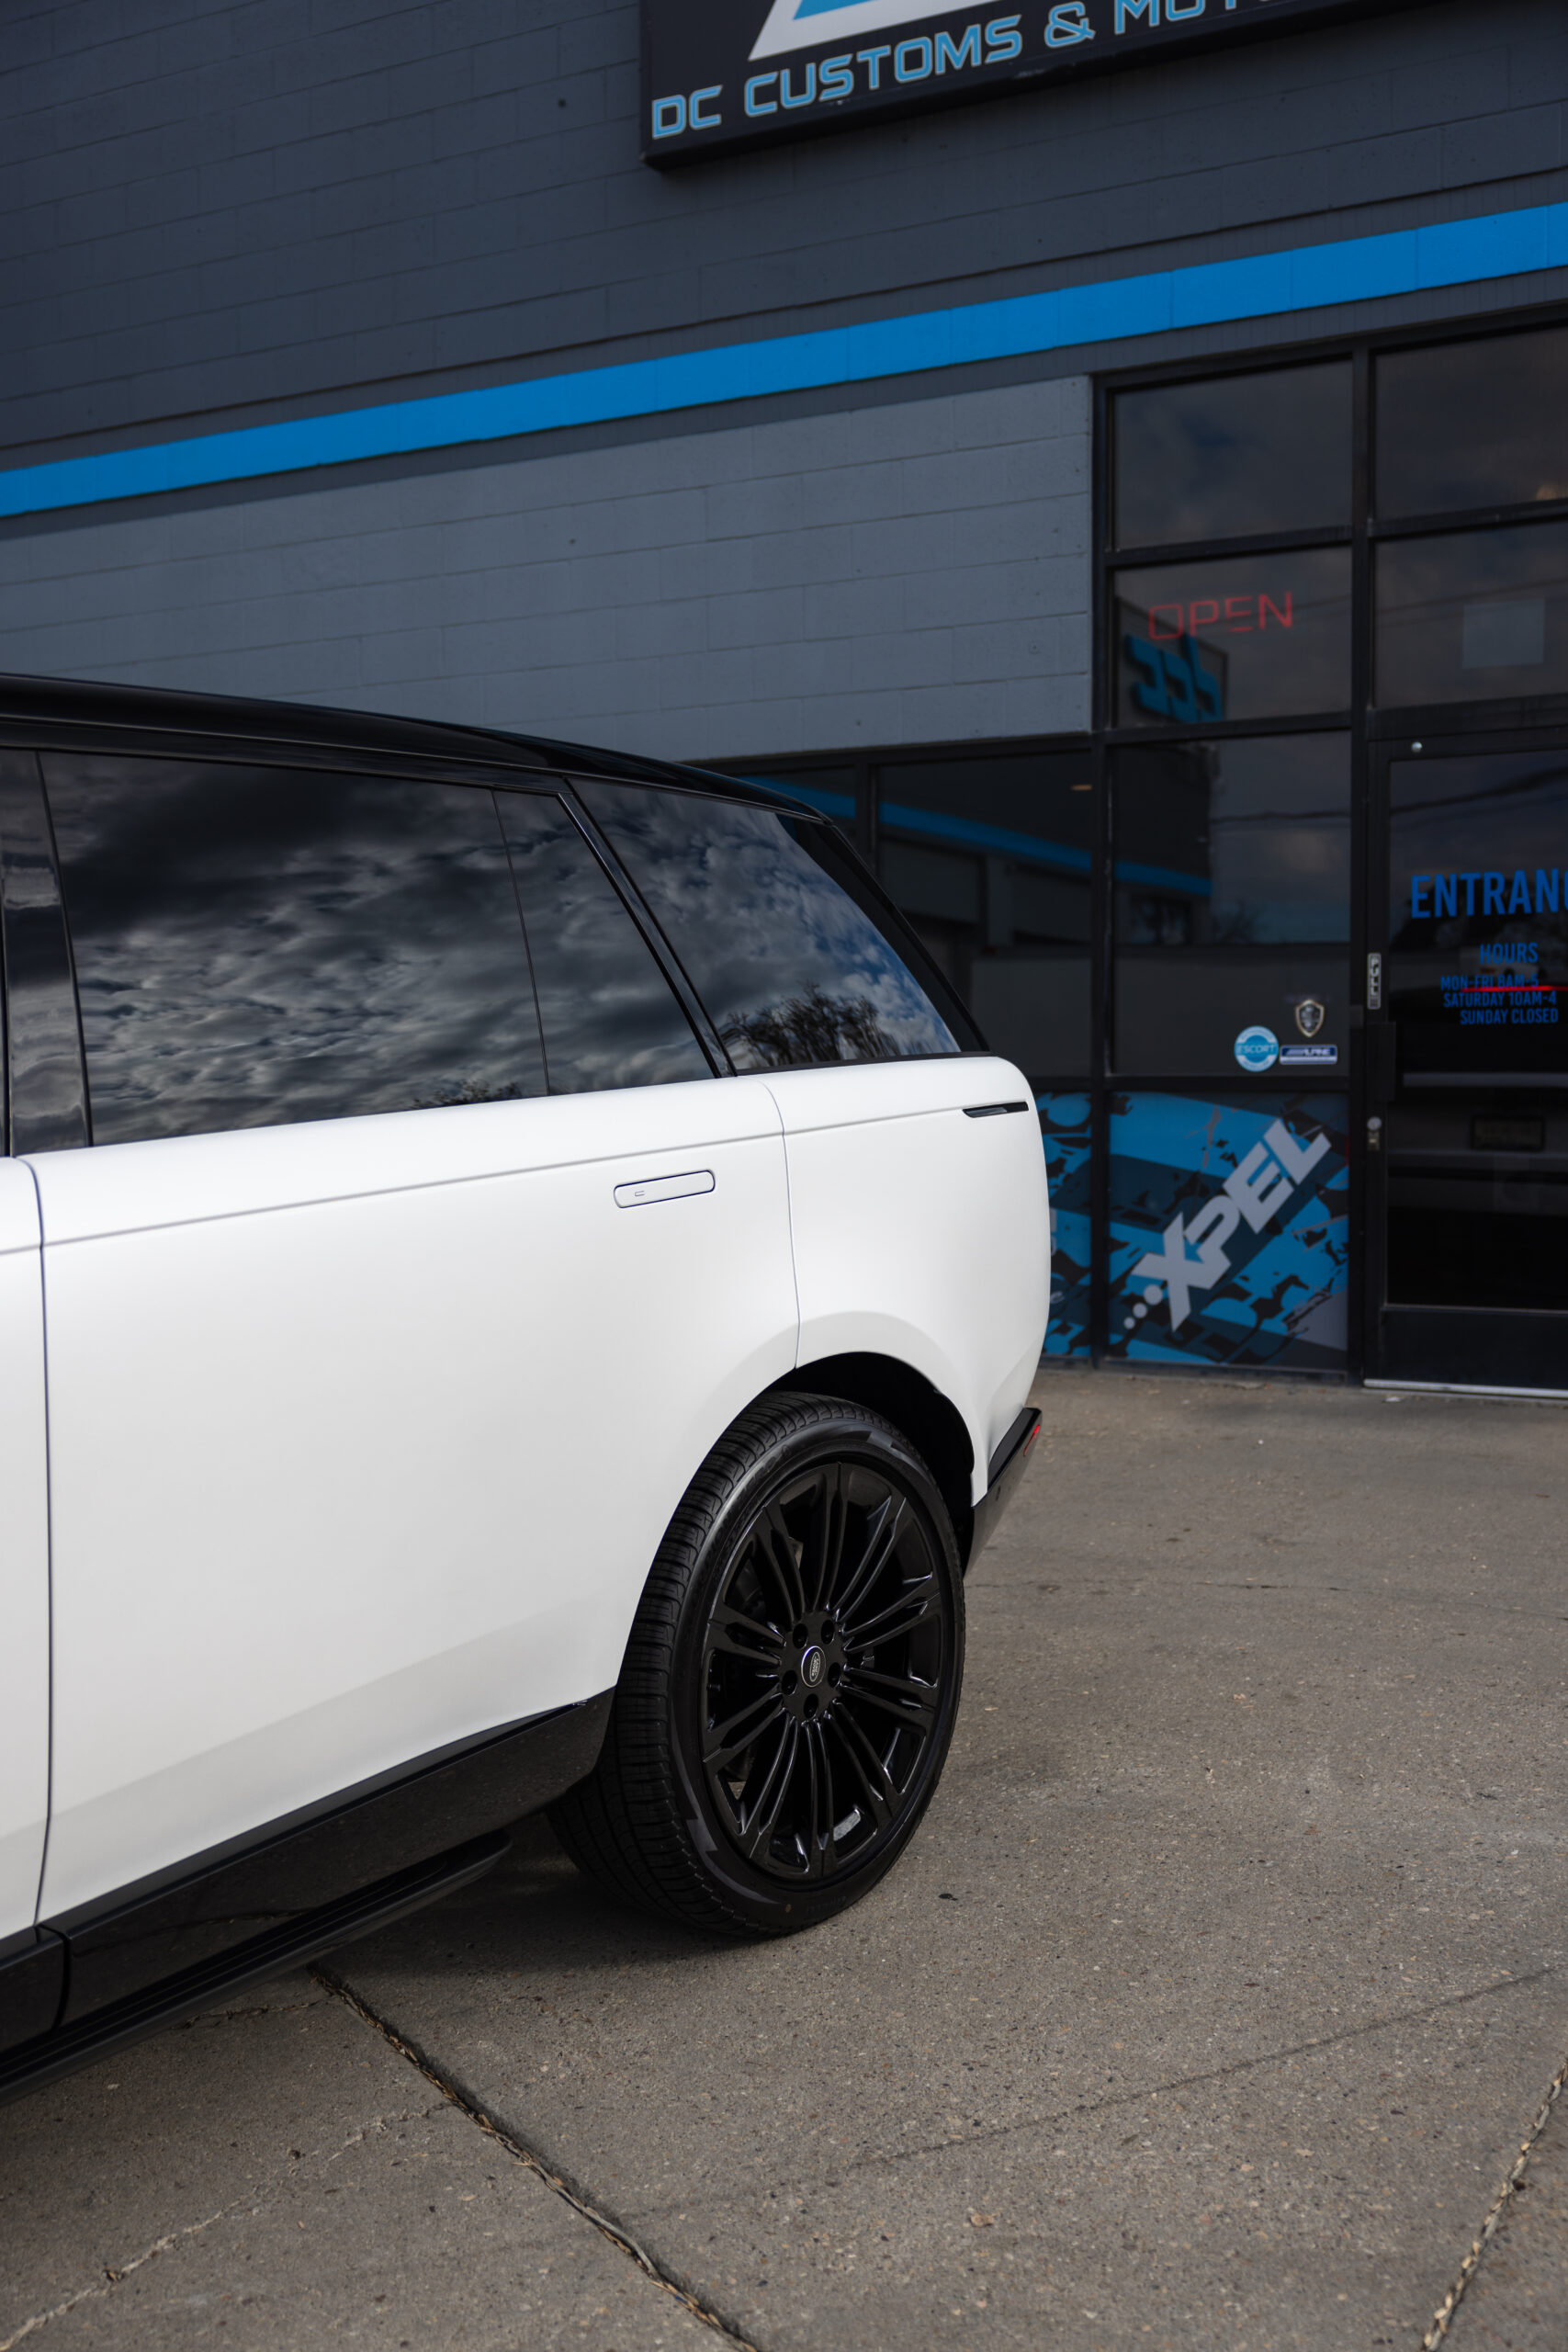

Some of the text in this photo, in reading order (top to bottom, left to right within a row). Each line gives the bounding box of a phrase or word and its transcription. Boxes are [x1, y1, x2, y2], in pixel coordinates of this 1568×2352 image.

[651, 85, 723, 140] DC
[744, 15, 1022, 118] CUSTOMS
[1044, 1, 1096, 49] &
[1149, 592, 1292, 639] OPEN
[1411, 868, 1568, 918] ENTRAN
[1479, 942, 1539, 965] HOURS
[1440, 975, 1494, 991] MON-FRI
[1443, 989, 1557, 1008] SATURDAY 10AM-4
[1460, 1007, 1559, 1025] SUNDAY CLOSED
[1131, 1118, 1332, 1332] XPEL
